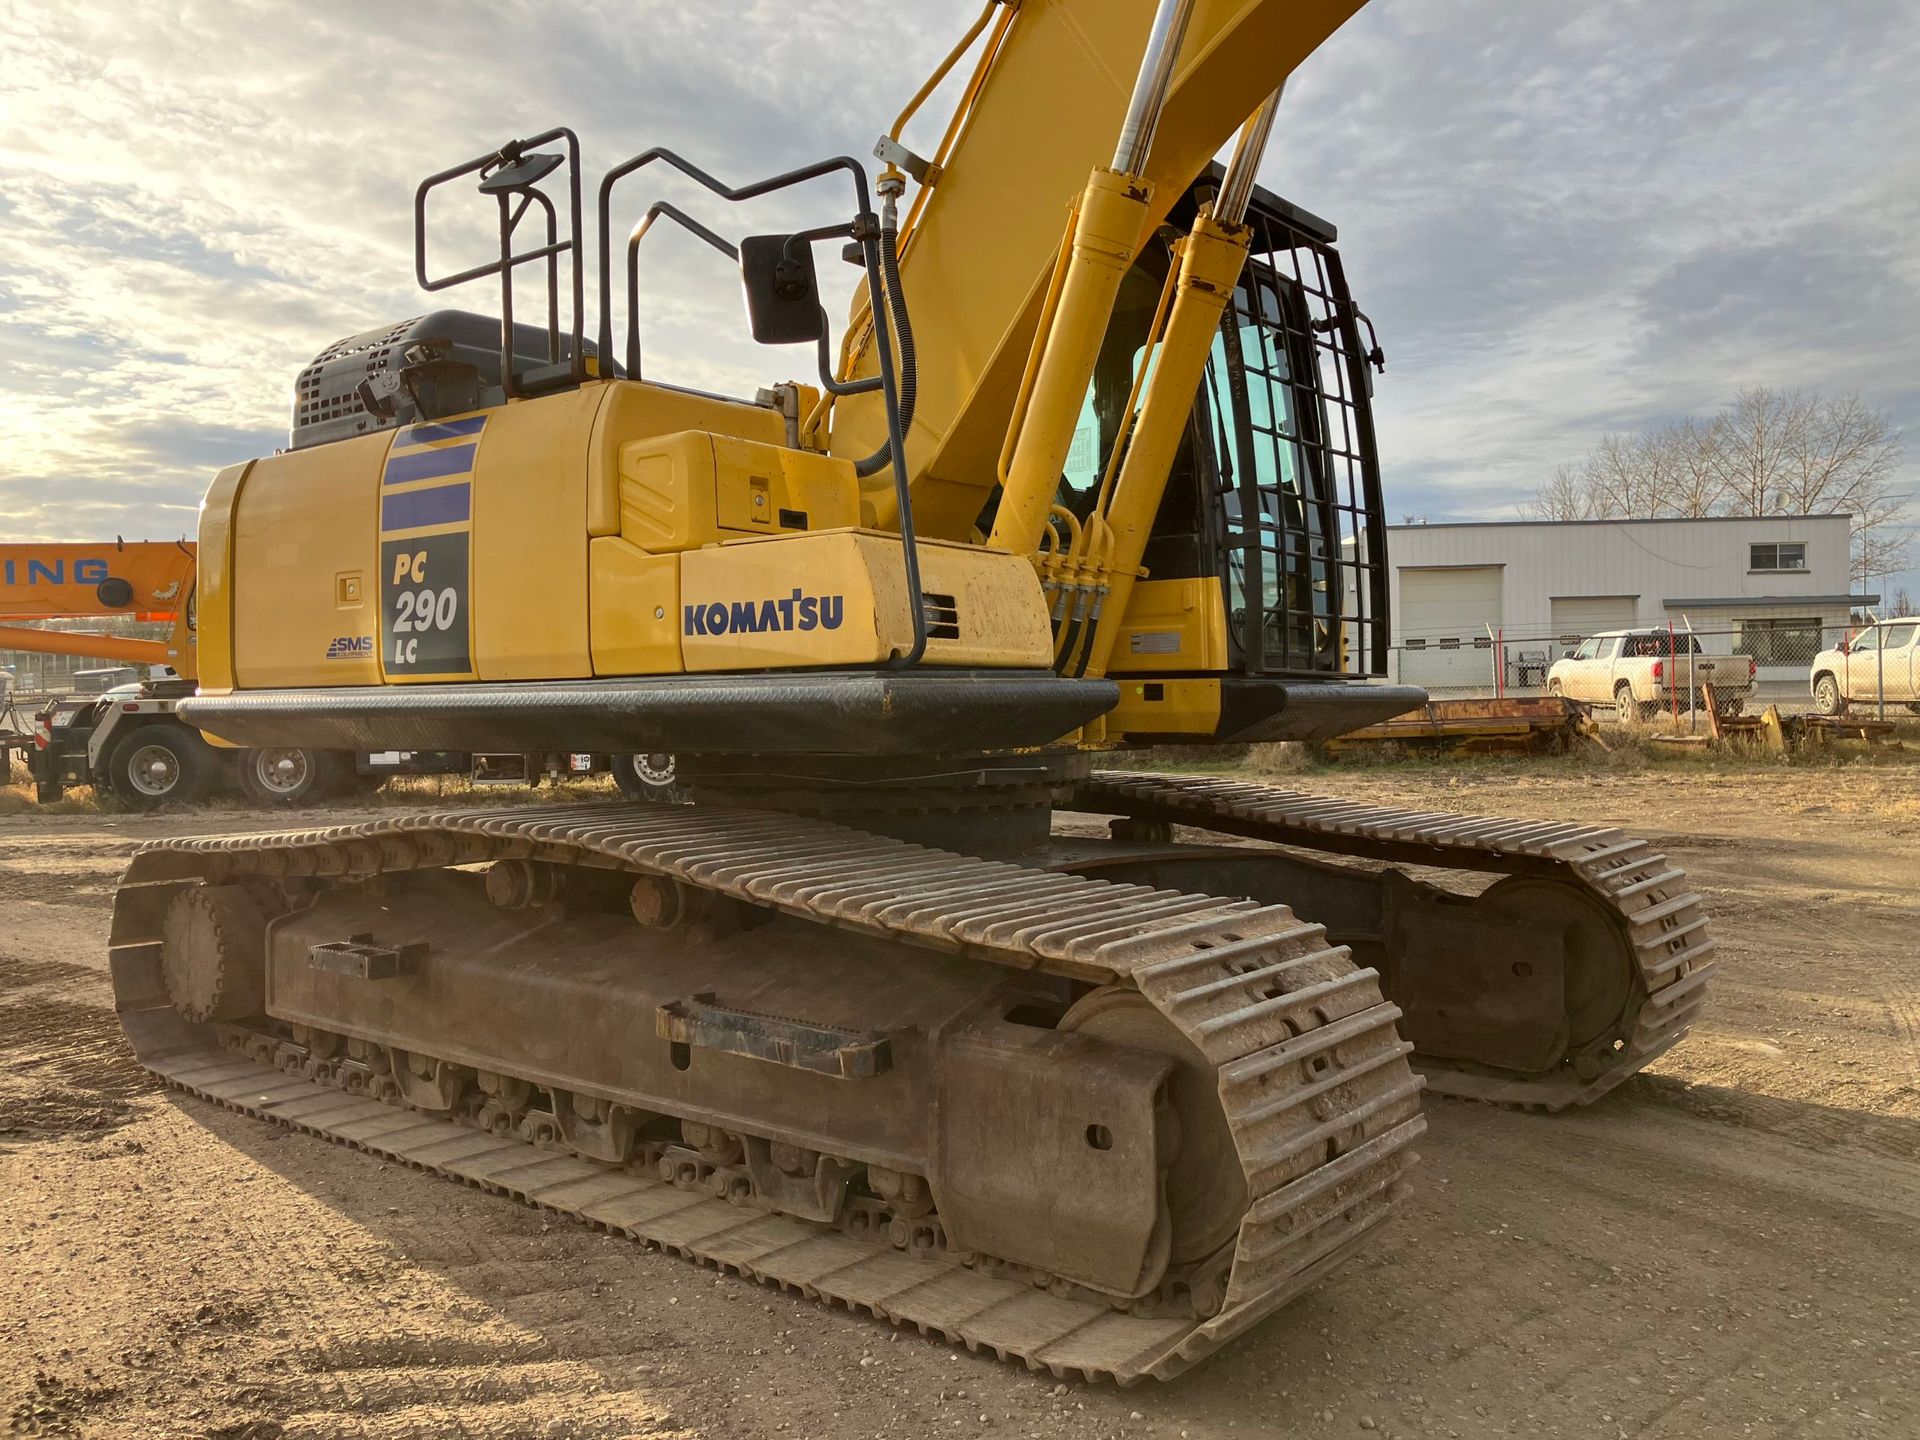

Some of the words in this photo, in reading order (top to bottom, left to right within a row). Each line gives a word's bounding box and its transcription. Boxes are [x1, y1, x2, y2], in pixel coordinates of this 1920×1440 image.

[393, 551, 428, 585] PC
[392, 587, 457, 633] 290
[684, 588, 843, 636] KOMATSU
[336, 636, 373, 652] SMS
[394, 638, 418, 664] LC
